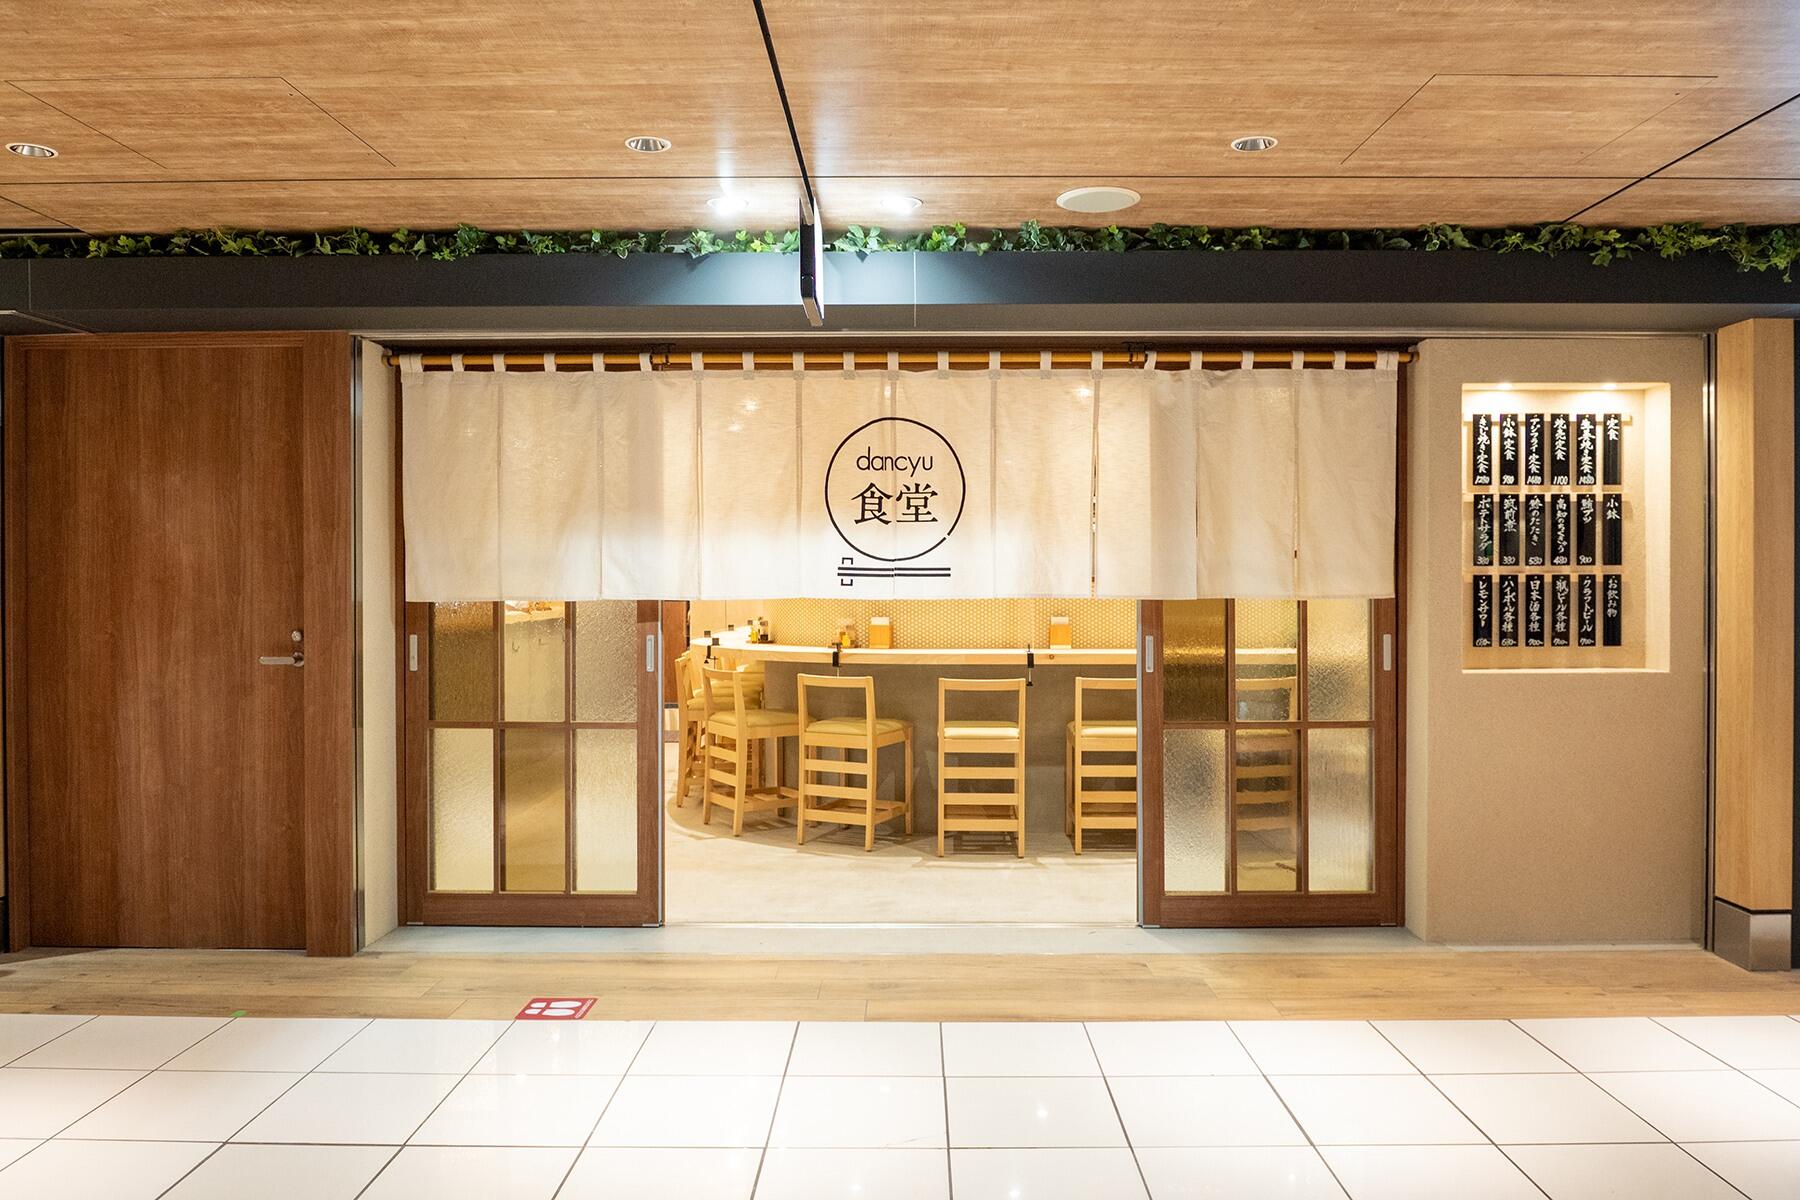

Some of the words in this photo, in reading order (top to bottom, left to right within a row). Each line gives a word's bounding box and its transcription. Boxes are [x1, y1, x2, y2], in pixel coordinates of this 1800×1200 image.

[1607, 418, 1620, 440] 定食
[856, 446, 934, 478] dancyu
[1553, 475, 1568, 485] 1100
[851, 482, 939, 526] 食堂
[1503, 498, 1517, 532] 筑前煮
[1606, 499, 1620, 520] 小鉢
[1477, 498, 1492, 551] ポテトサラダ
[1478, 581, 1489, 627] レモンサワー
[1529, 580, 1542, 632] 日本酒各種
[1581, 580, 1594, 632] クラフトビール
[1607, 578, 1619, 617] お飲み物
